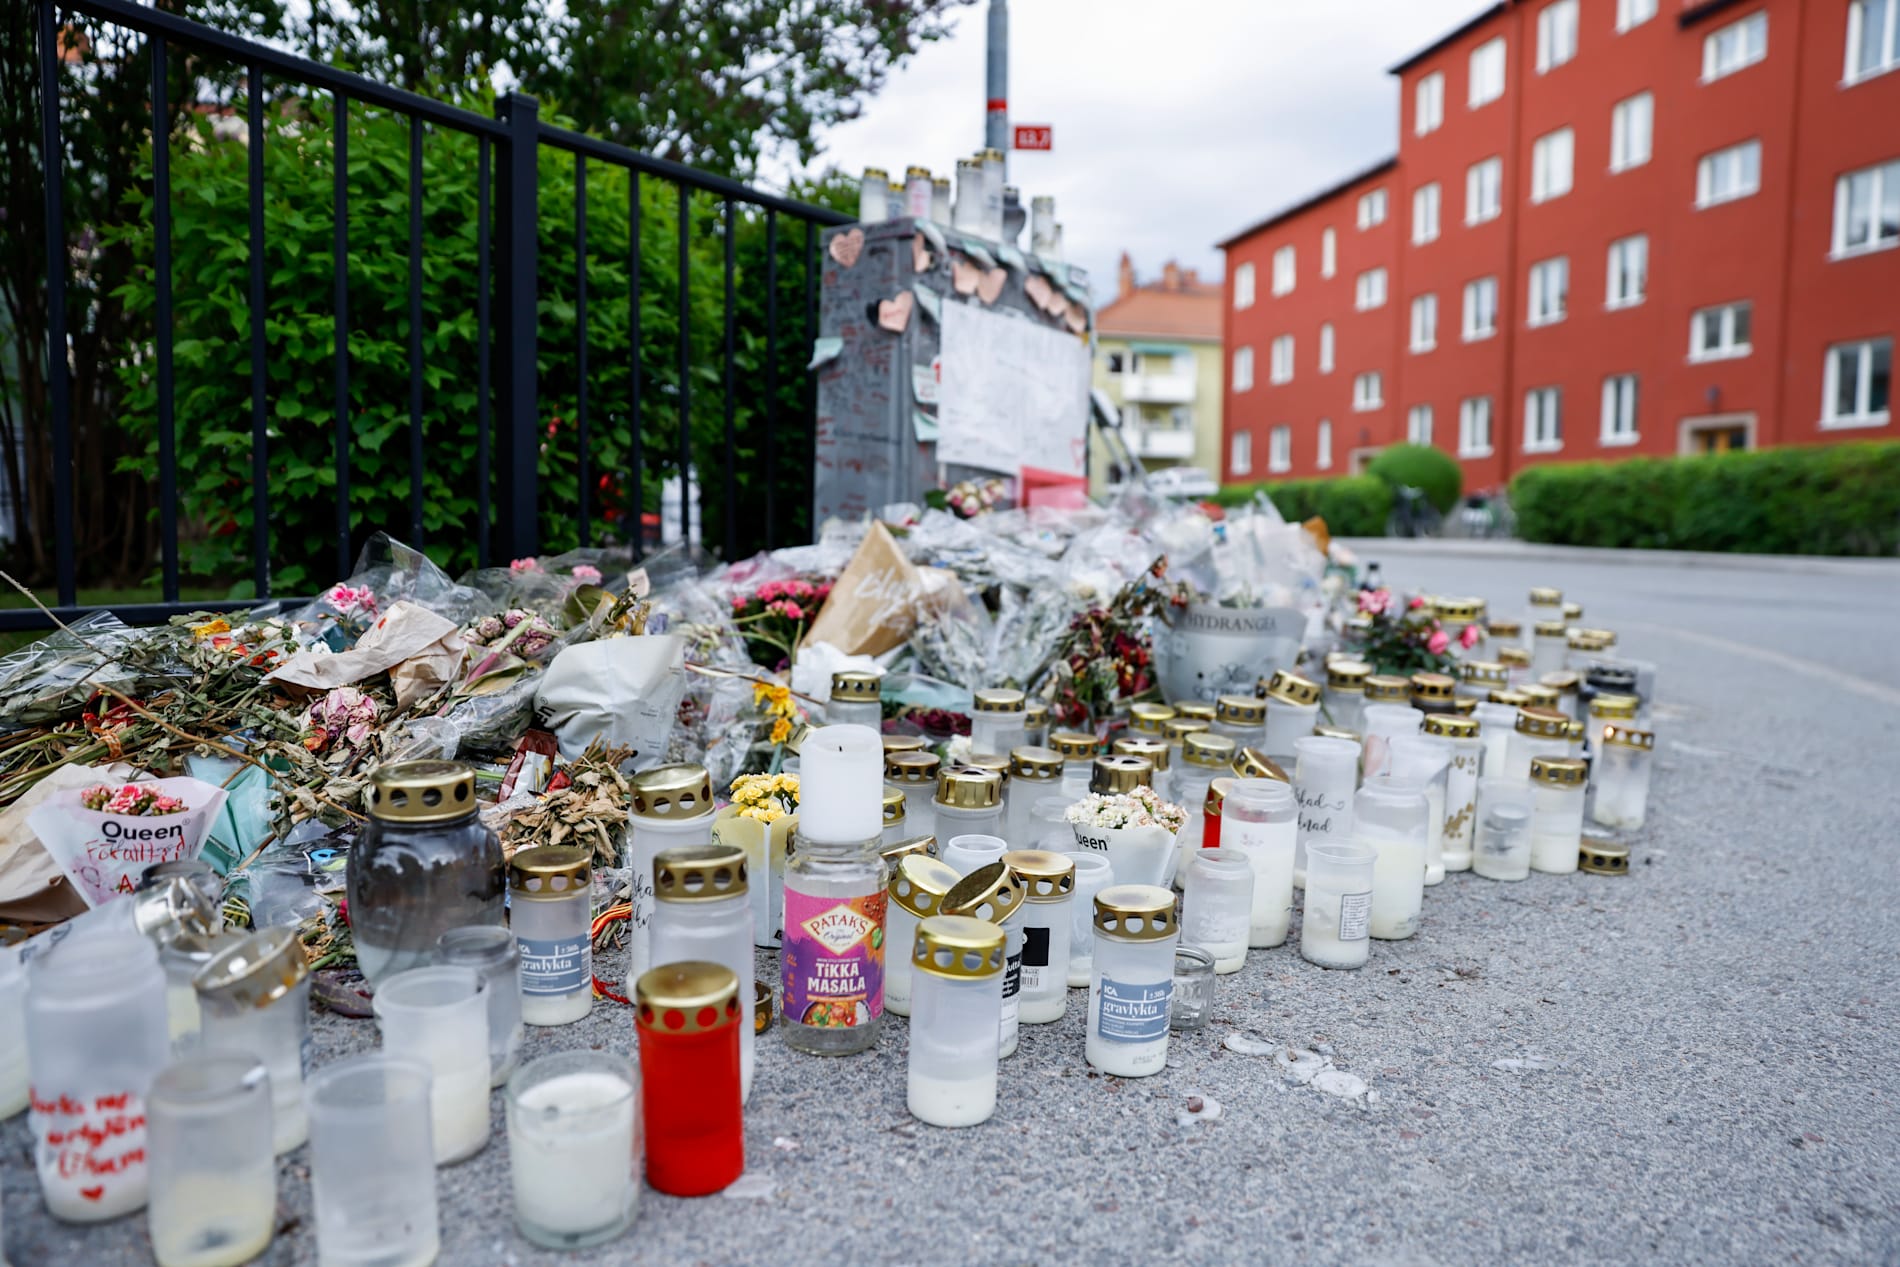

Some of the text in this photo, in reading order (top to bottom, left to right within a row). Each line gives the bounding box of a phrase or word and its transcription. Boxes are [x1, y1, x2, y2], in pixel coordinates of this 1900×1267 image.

[101, 820, 183, 843] Queen
[807, 976, 866, 993] MASALA
[1103, 984, 1119, 997] ICA
[1102, 1000, 1158, 1019] gravlykta
